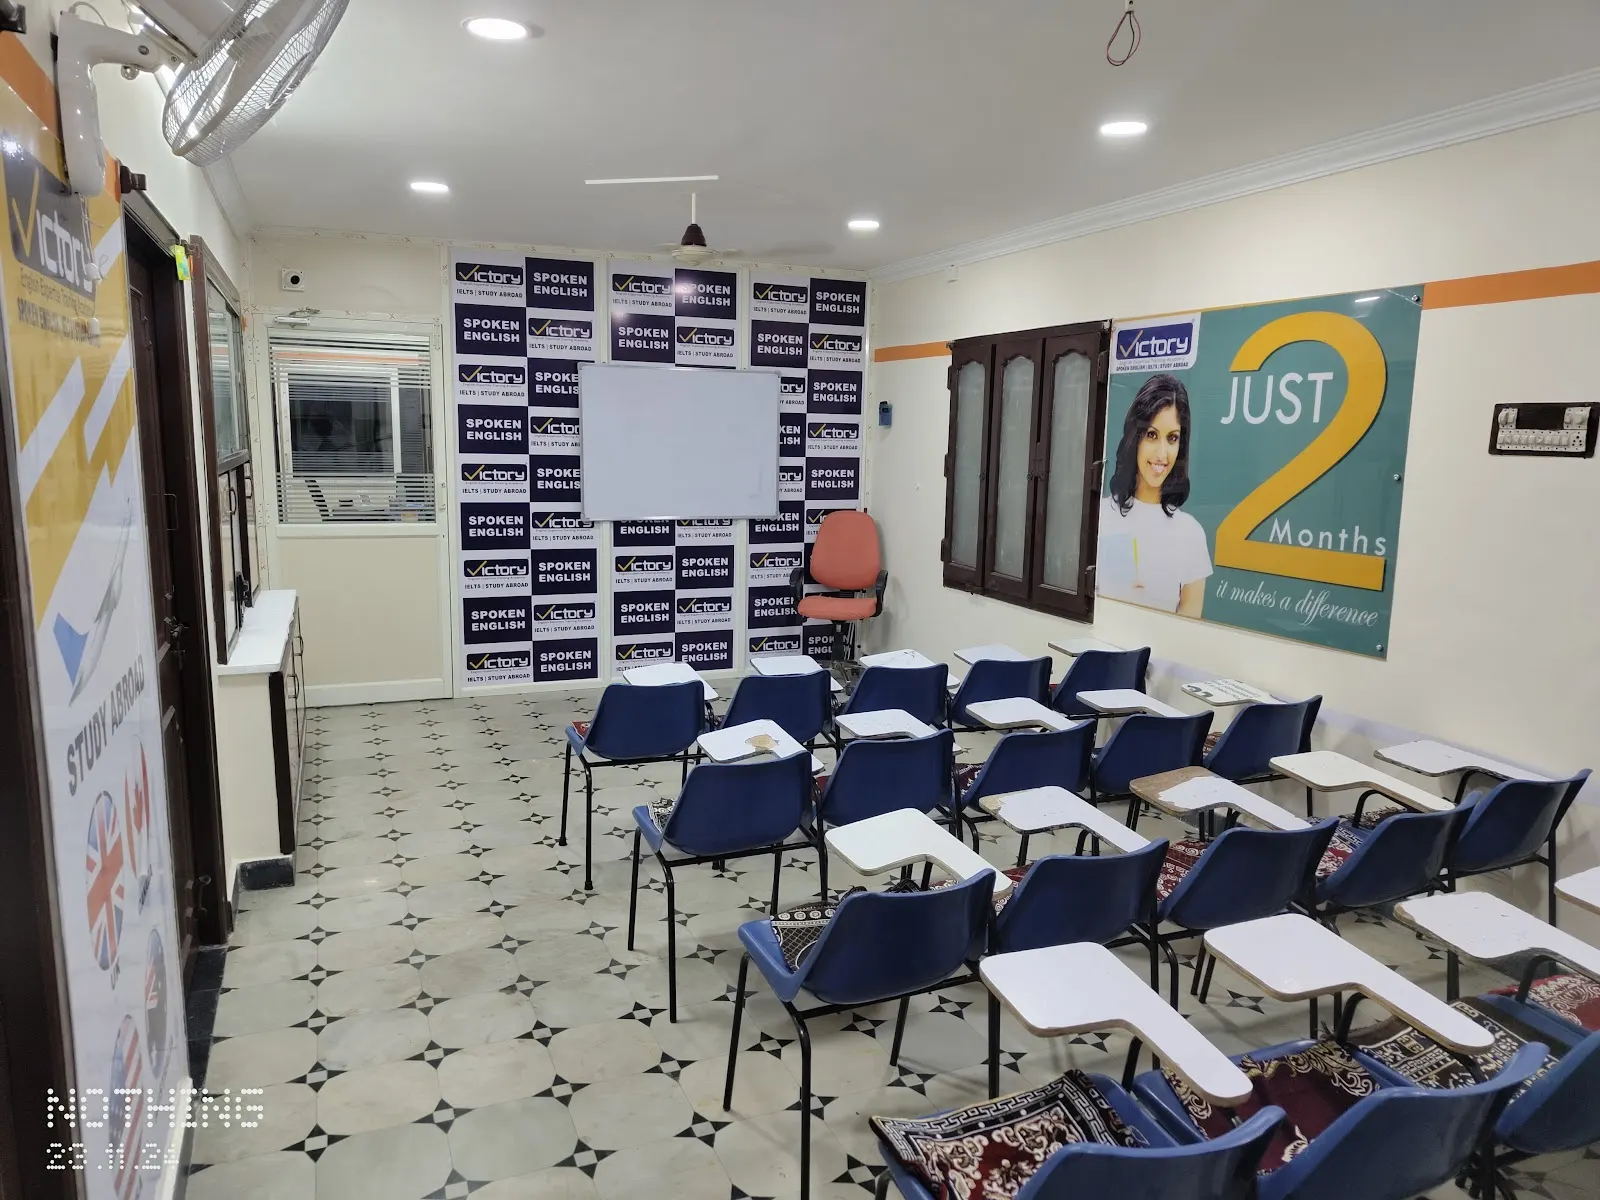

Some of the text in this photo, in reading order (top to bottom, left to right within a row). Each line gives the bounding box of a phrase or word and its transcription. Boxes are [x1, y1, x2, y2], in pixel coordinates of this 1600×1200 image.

[533, 272, 587, 285] SPOKEN
[534, 285, 588, 297] ENGLISH
[681, 283, 730, 295] SPOKEN
[682, 296, 730, 306] ENGLISH
[816, 291, 860, 302] SPOKEN
[815, 304, 860, 314] ENGLISH
[464, 318, 519, 330] SPOKEN
[464, 331, 519, 343] ENGLISH
[618, 327, 668, 338] SPOKEN
[618, 339, 668, 349] ENGLISH
[758, 333, 803, 344] SPOKEN
[1120, 330, 1188, 357] Victory
[757, 345, 802, 356] ENGLISH
[535, 372, 578, 383] SPOKE
[535, 384, 579, 394] ENGLIS
[813, 382, 856, 392] SPOKEN
[813, 394, 856, 402] ENGLISH
[1220, 372, 1334, 425] JUST
[466, 418, 521, 429] SPOKEN
[533, 418, 579, 434] Victor
[466, 431, 522, 441] ENGLISH
[1215, 311, 1388, 592] 2
[537, 468, 580, 478] SPOKE
[811, 470, 854, 478] SPOKEN
[537, 481, 580, 489] ENGLIS
[811, 480, 854, 488] ENGLISH
[469, 516, 523, 525] SPOKEN
[469, 528, 524, 537] ENGLISH
[620, 526, 669, 534] ENGLISH
[755, 524, 799, 532] ENGLISH
[1269, 517, 1387, 556] Months
[539, 562, 591, 571] SPOKEN
[682, 557, 728, 567] SPOKEN
[539, 573, 591, 582] ENGLISH
[682, 568, 728, 577] ENGLISH
[621, 602, 669, 613] SPOKEN
[1216, 580, 1229, 598] it
[1280, 596, 1292, 611] a
[1295, 590, 1378, 626] difference
[471, 609, 526, 620] SPOKEN
[621, 613, 669, 623] ENGLISH
[472, 621, 526, 631] ENGLISH
[682, 641, 727, 652] SPOKEN
[808, 645, 832, 655] ENGL
[540, 650, 591, 662] SPOKEN
[682, 652, 727, 663] ENGLISH
[541, 662, 592, 673] ENGLISH
[66, 653, 145, 796] STUDY ABROAD
